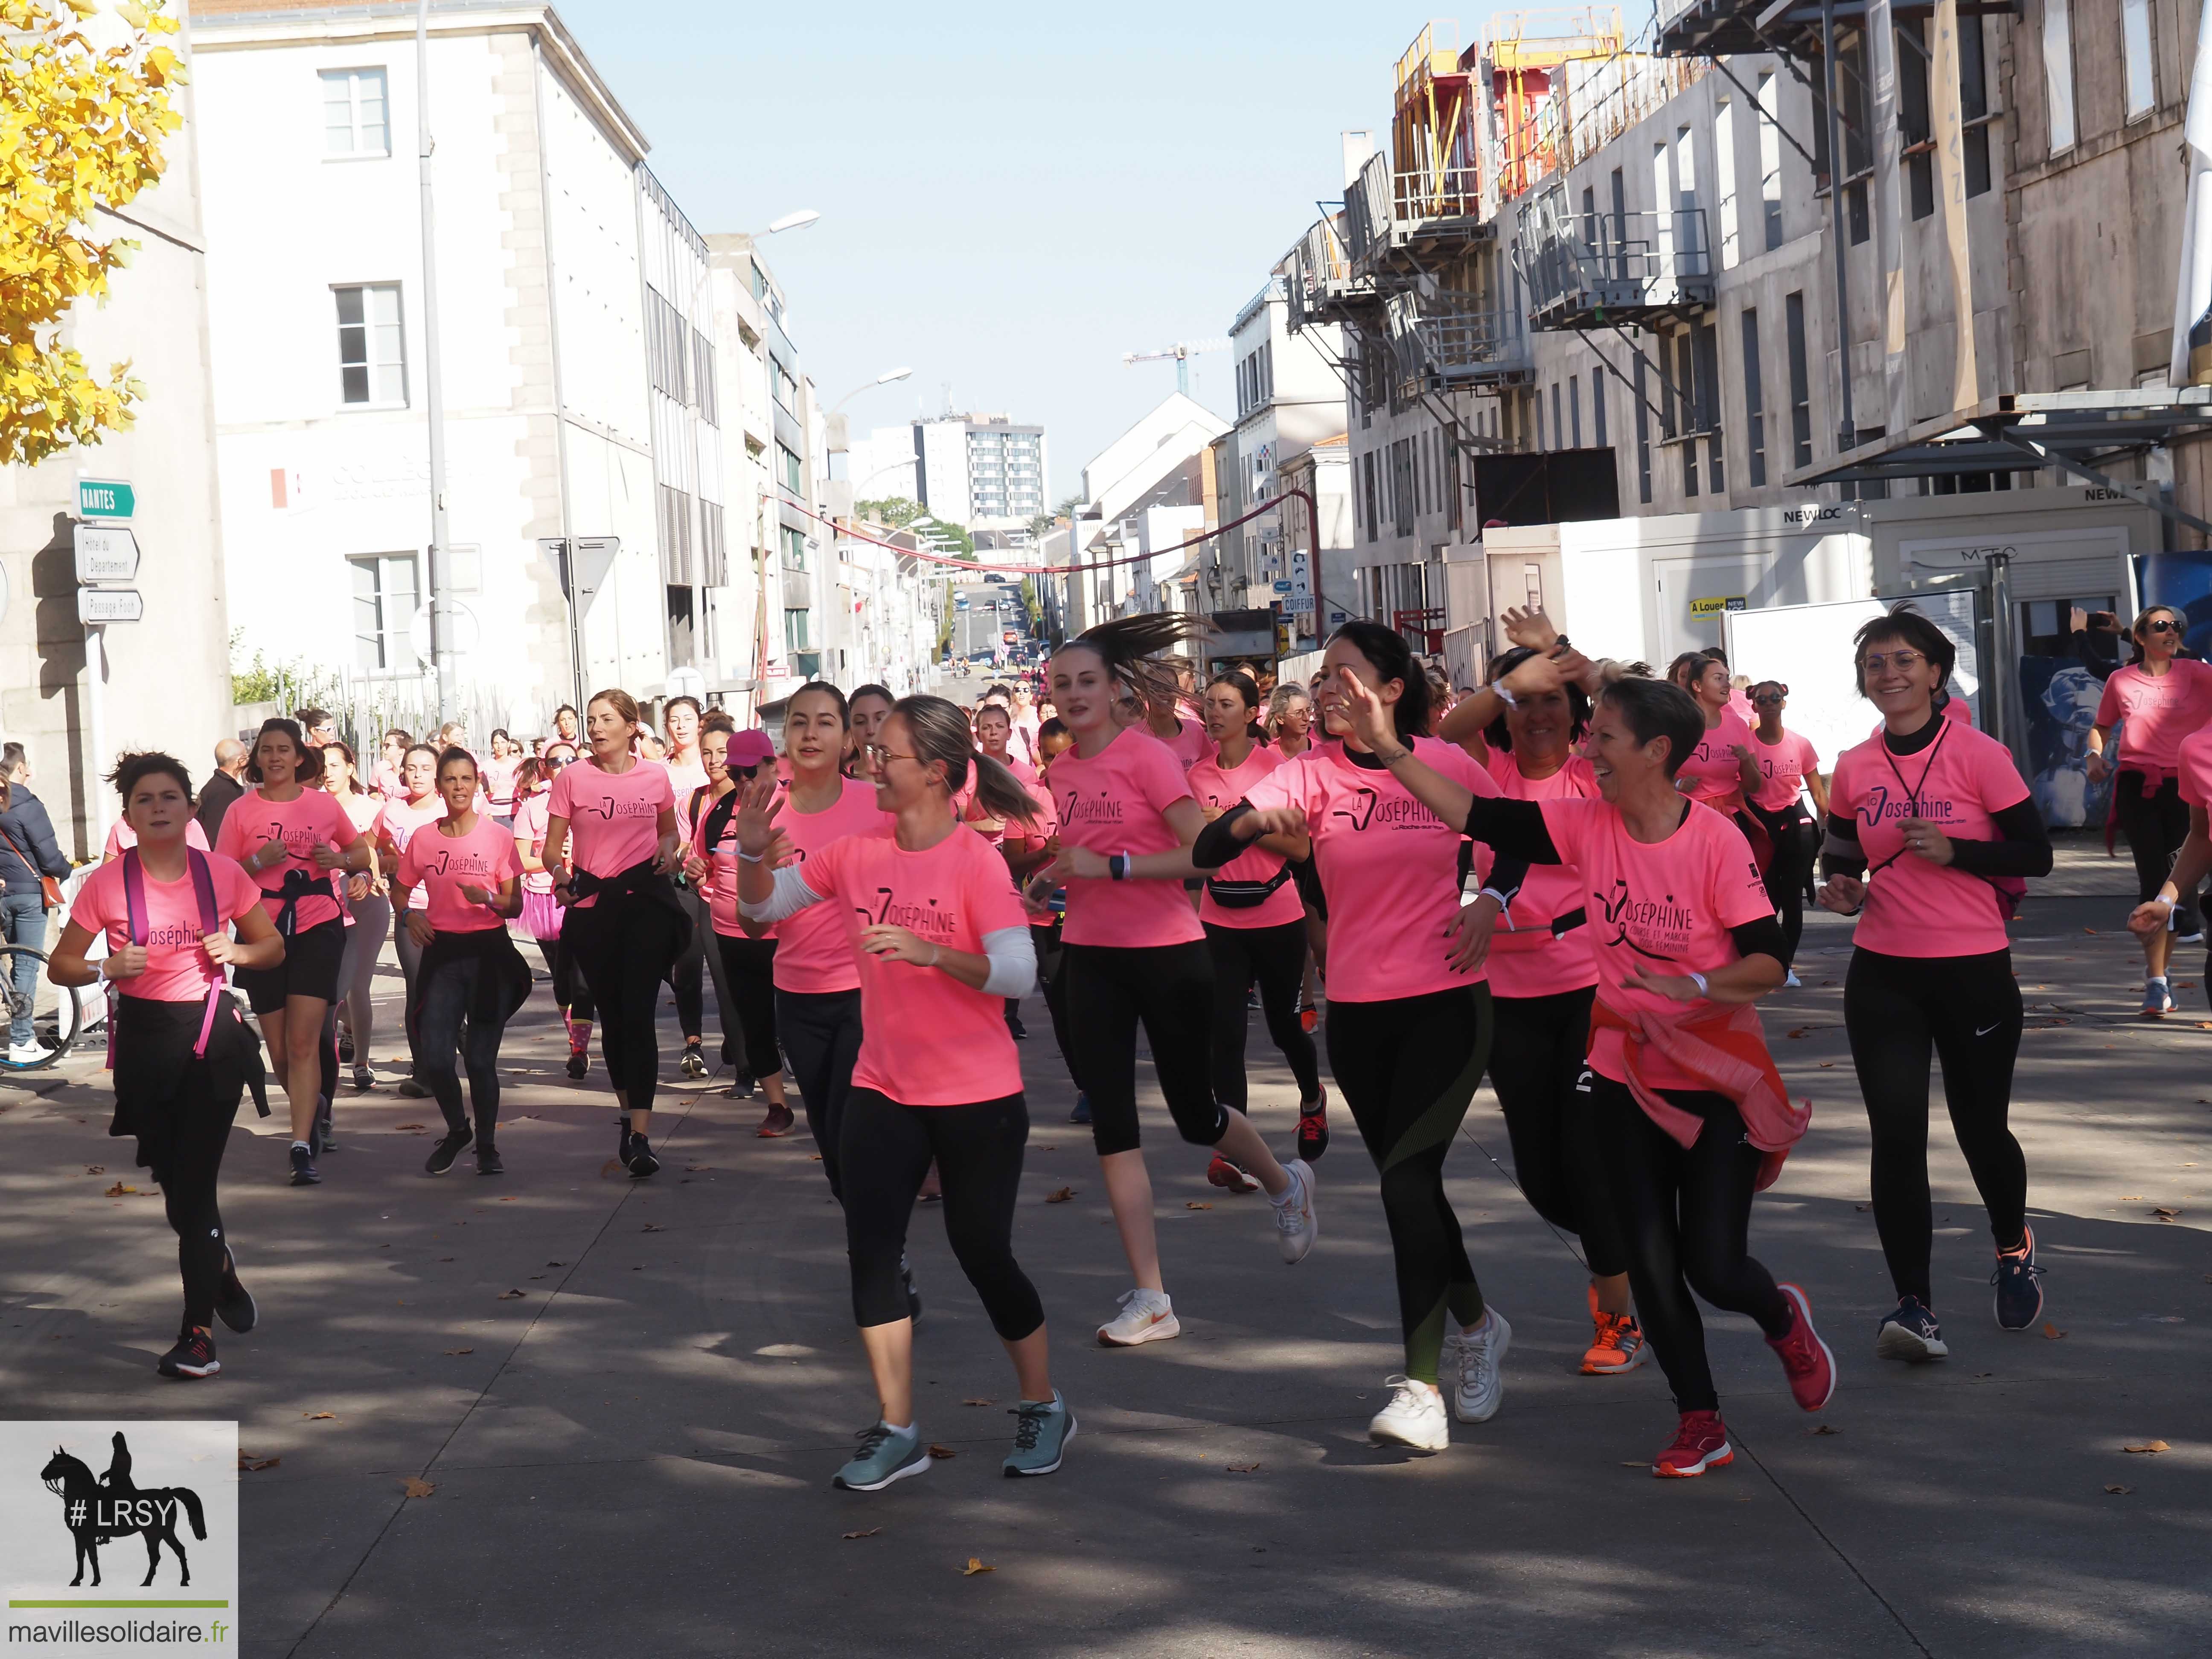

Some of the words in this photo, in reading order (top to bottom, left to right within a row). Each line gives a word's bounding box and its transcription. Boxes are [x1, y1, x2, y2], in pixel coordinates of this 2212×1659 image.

[82, 489, 115, 509] NANTES
[1784, 508, 1841, 523] NEWLOC
[85, 536, 100, 551] Hôtel
[102, 537, 110, 551] du
[90, 599, 116, 617] Passage
[1285, 598, 1314, 610] COIFFUR
[1692, 603, 1697, 612] A
[1700, 602, 1723, 611] Louer
[1352, 797, 1362, 810] LA
[1868, 795, 1877, 806] la
[1333, 788, 1444, 831] JOSÉPHIN
[268, 827, 274, 835] LA
[426, 851, 488, 876] JOSÉPHINE
[1594, 878, 1693, 930] JOSÉPHINE
[1653, 930, 1660, 939] ET
[1665, 932, 1689, 943] MARCHE
